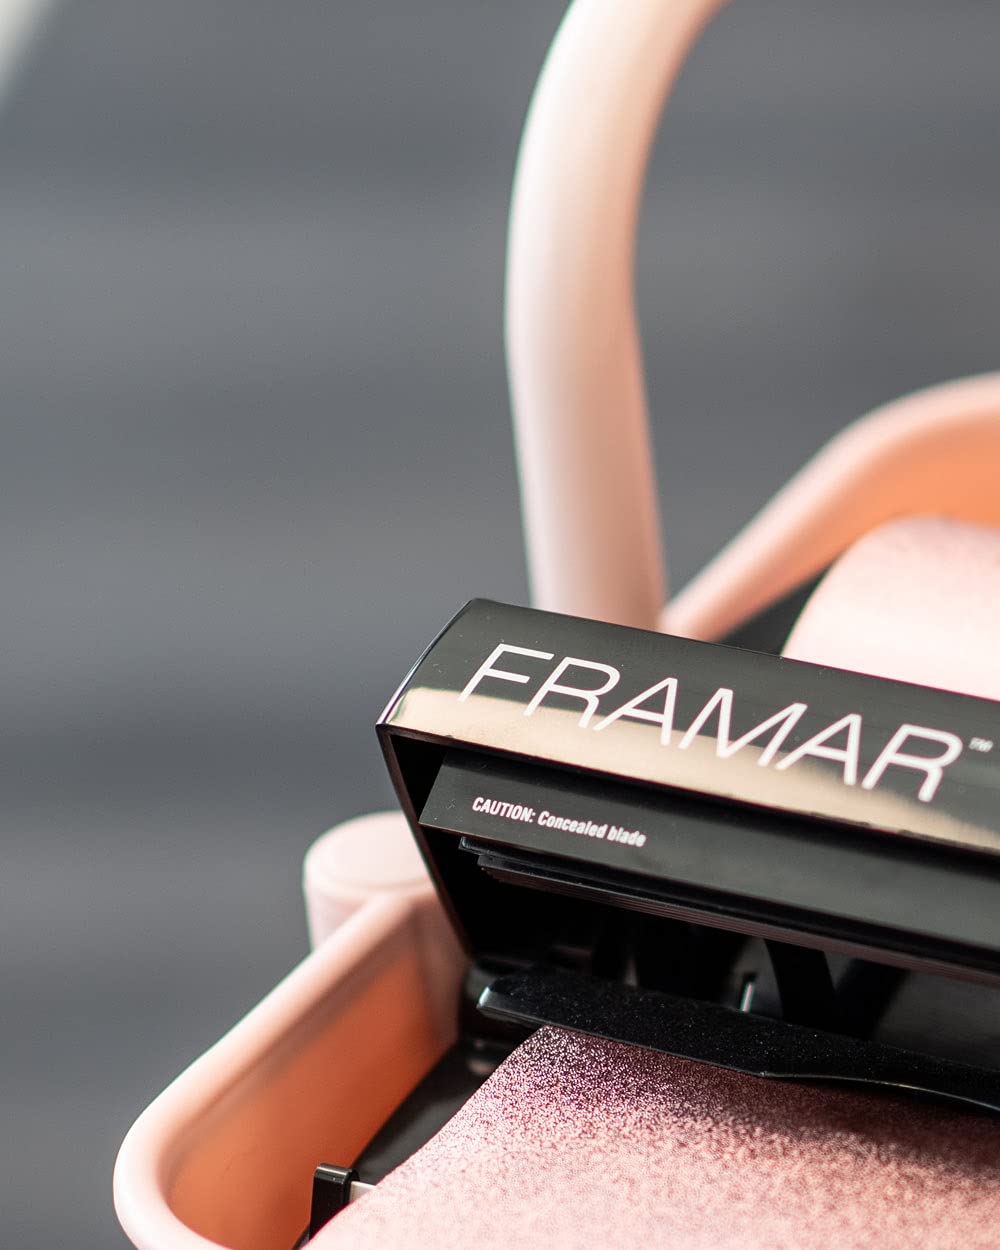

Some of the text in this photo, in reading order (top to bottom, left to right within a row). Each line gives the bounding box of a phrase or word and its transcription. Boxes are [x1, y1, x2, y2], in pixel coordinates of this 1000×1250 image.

[472, 797, 647, 847] CAUTION: Concealed blade
